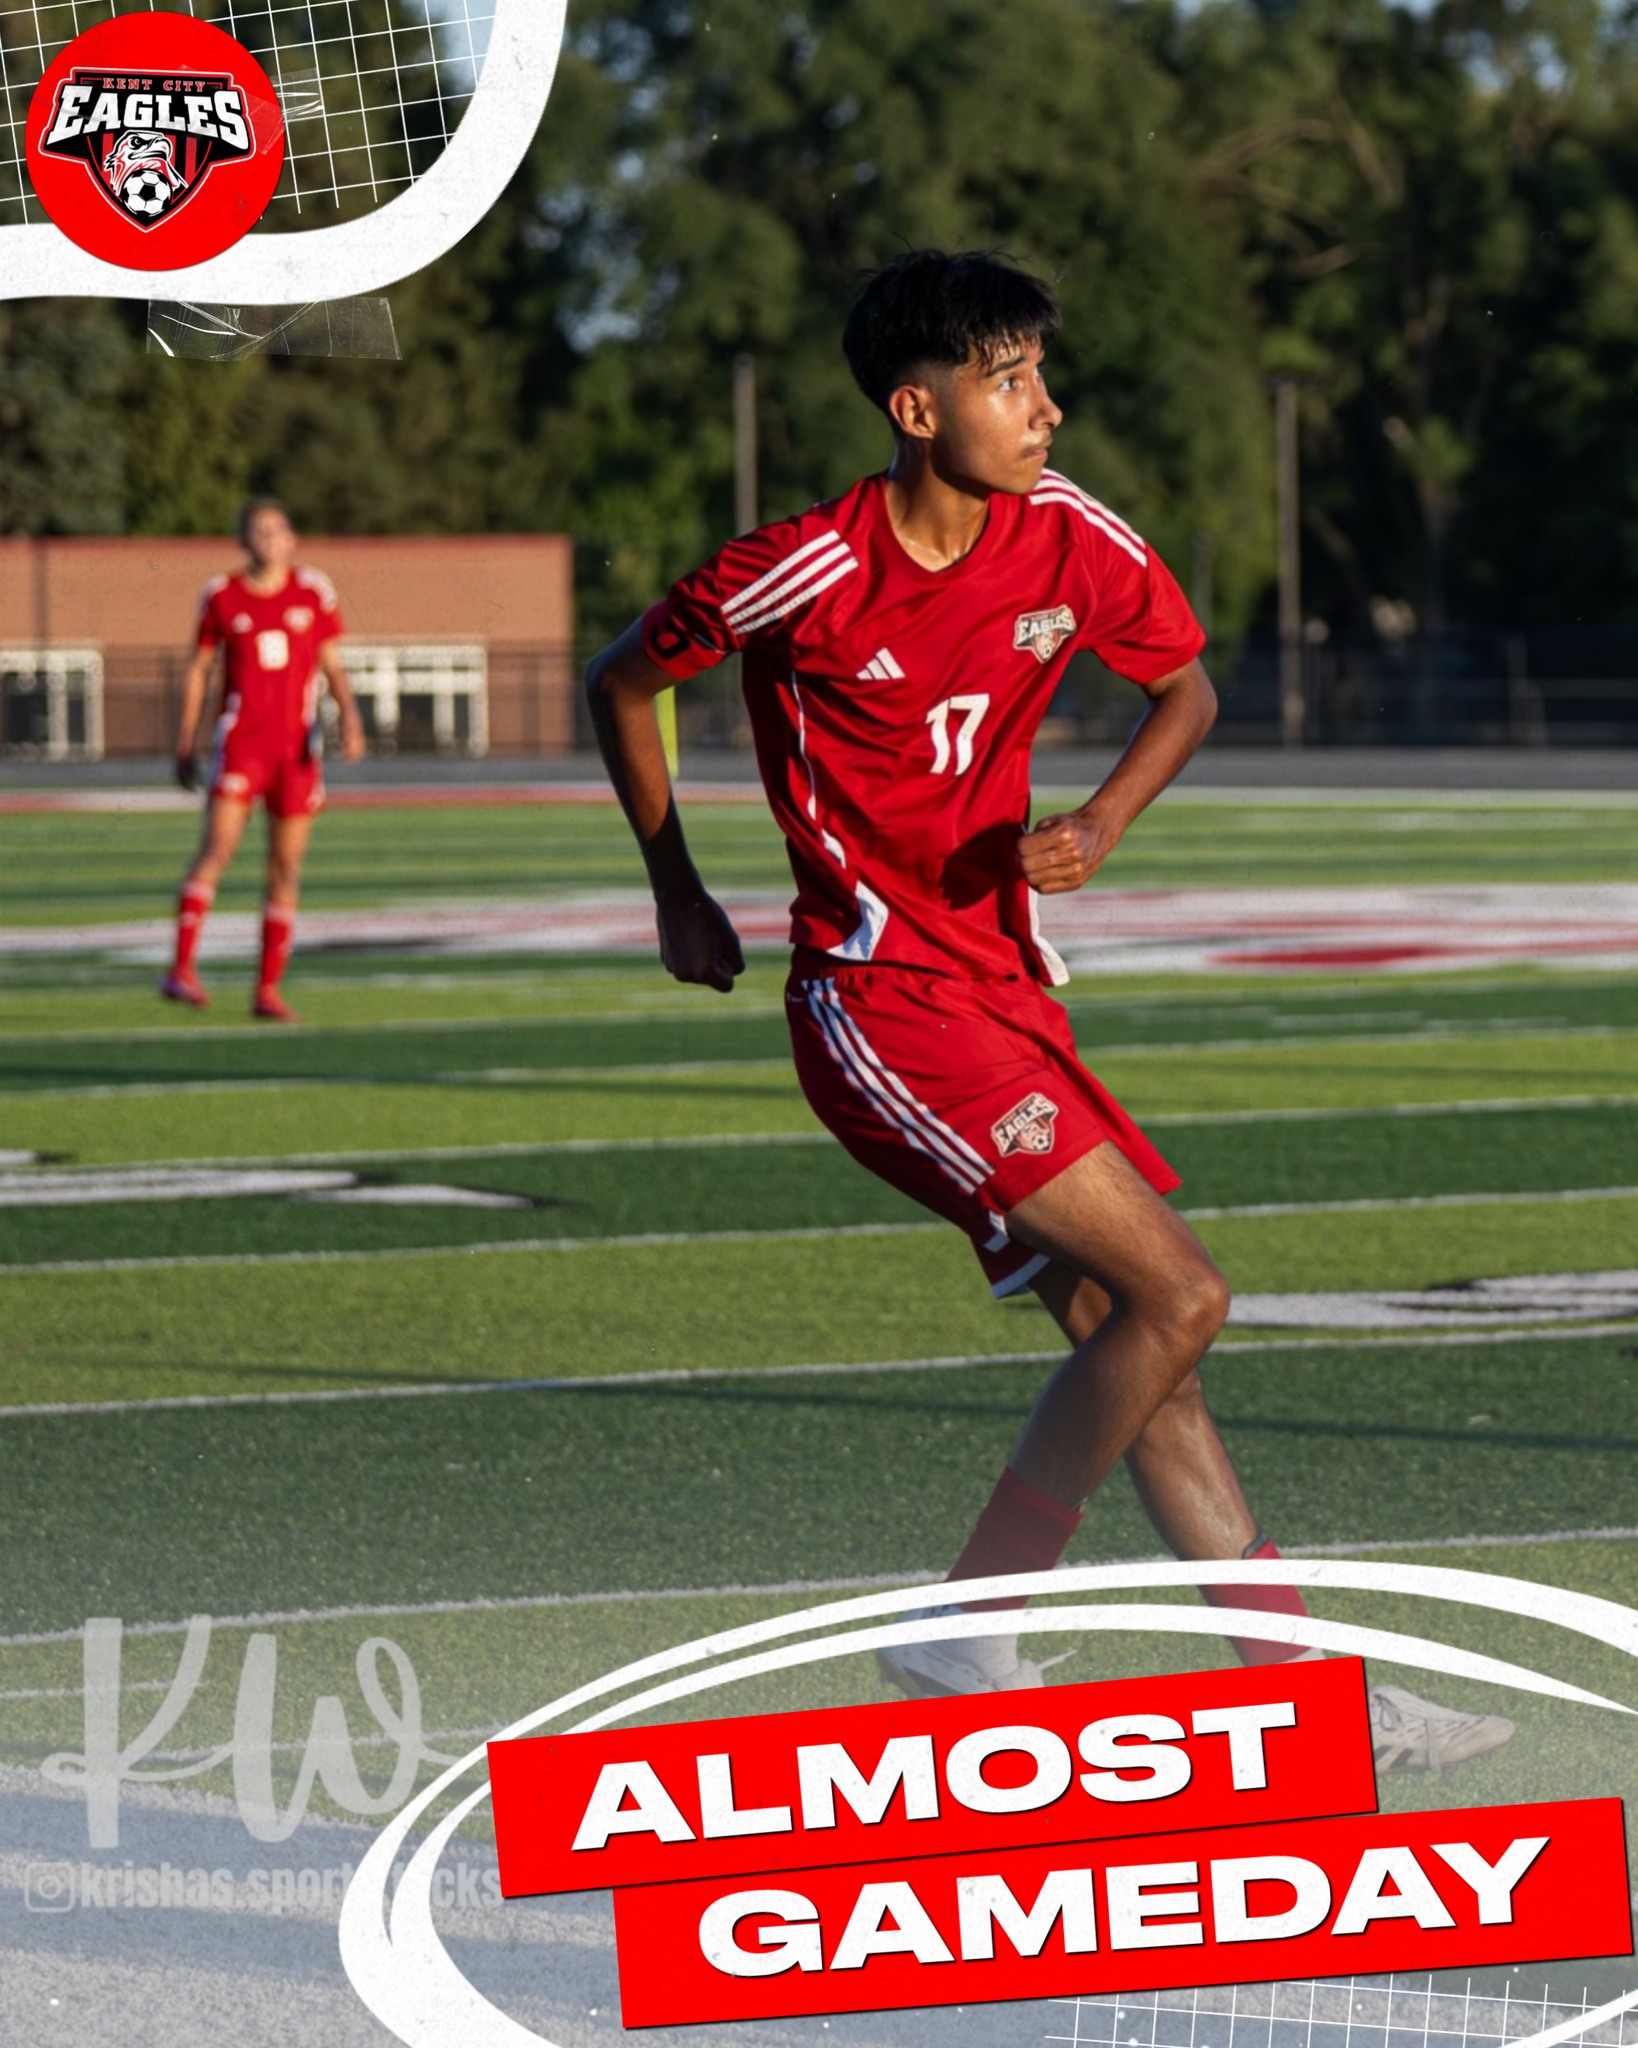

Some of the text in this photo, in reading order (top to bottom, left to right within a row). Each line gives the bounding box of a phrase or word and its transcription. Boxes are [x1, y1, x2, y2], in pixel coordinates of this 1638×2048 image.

[1016, 609, 1075, 646] EAGLES
[924, 693, 990, 776] 17
[995, 1096, 1055, 1154] EAGLES
